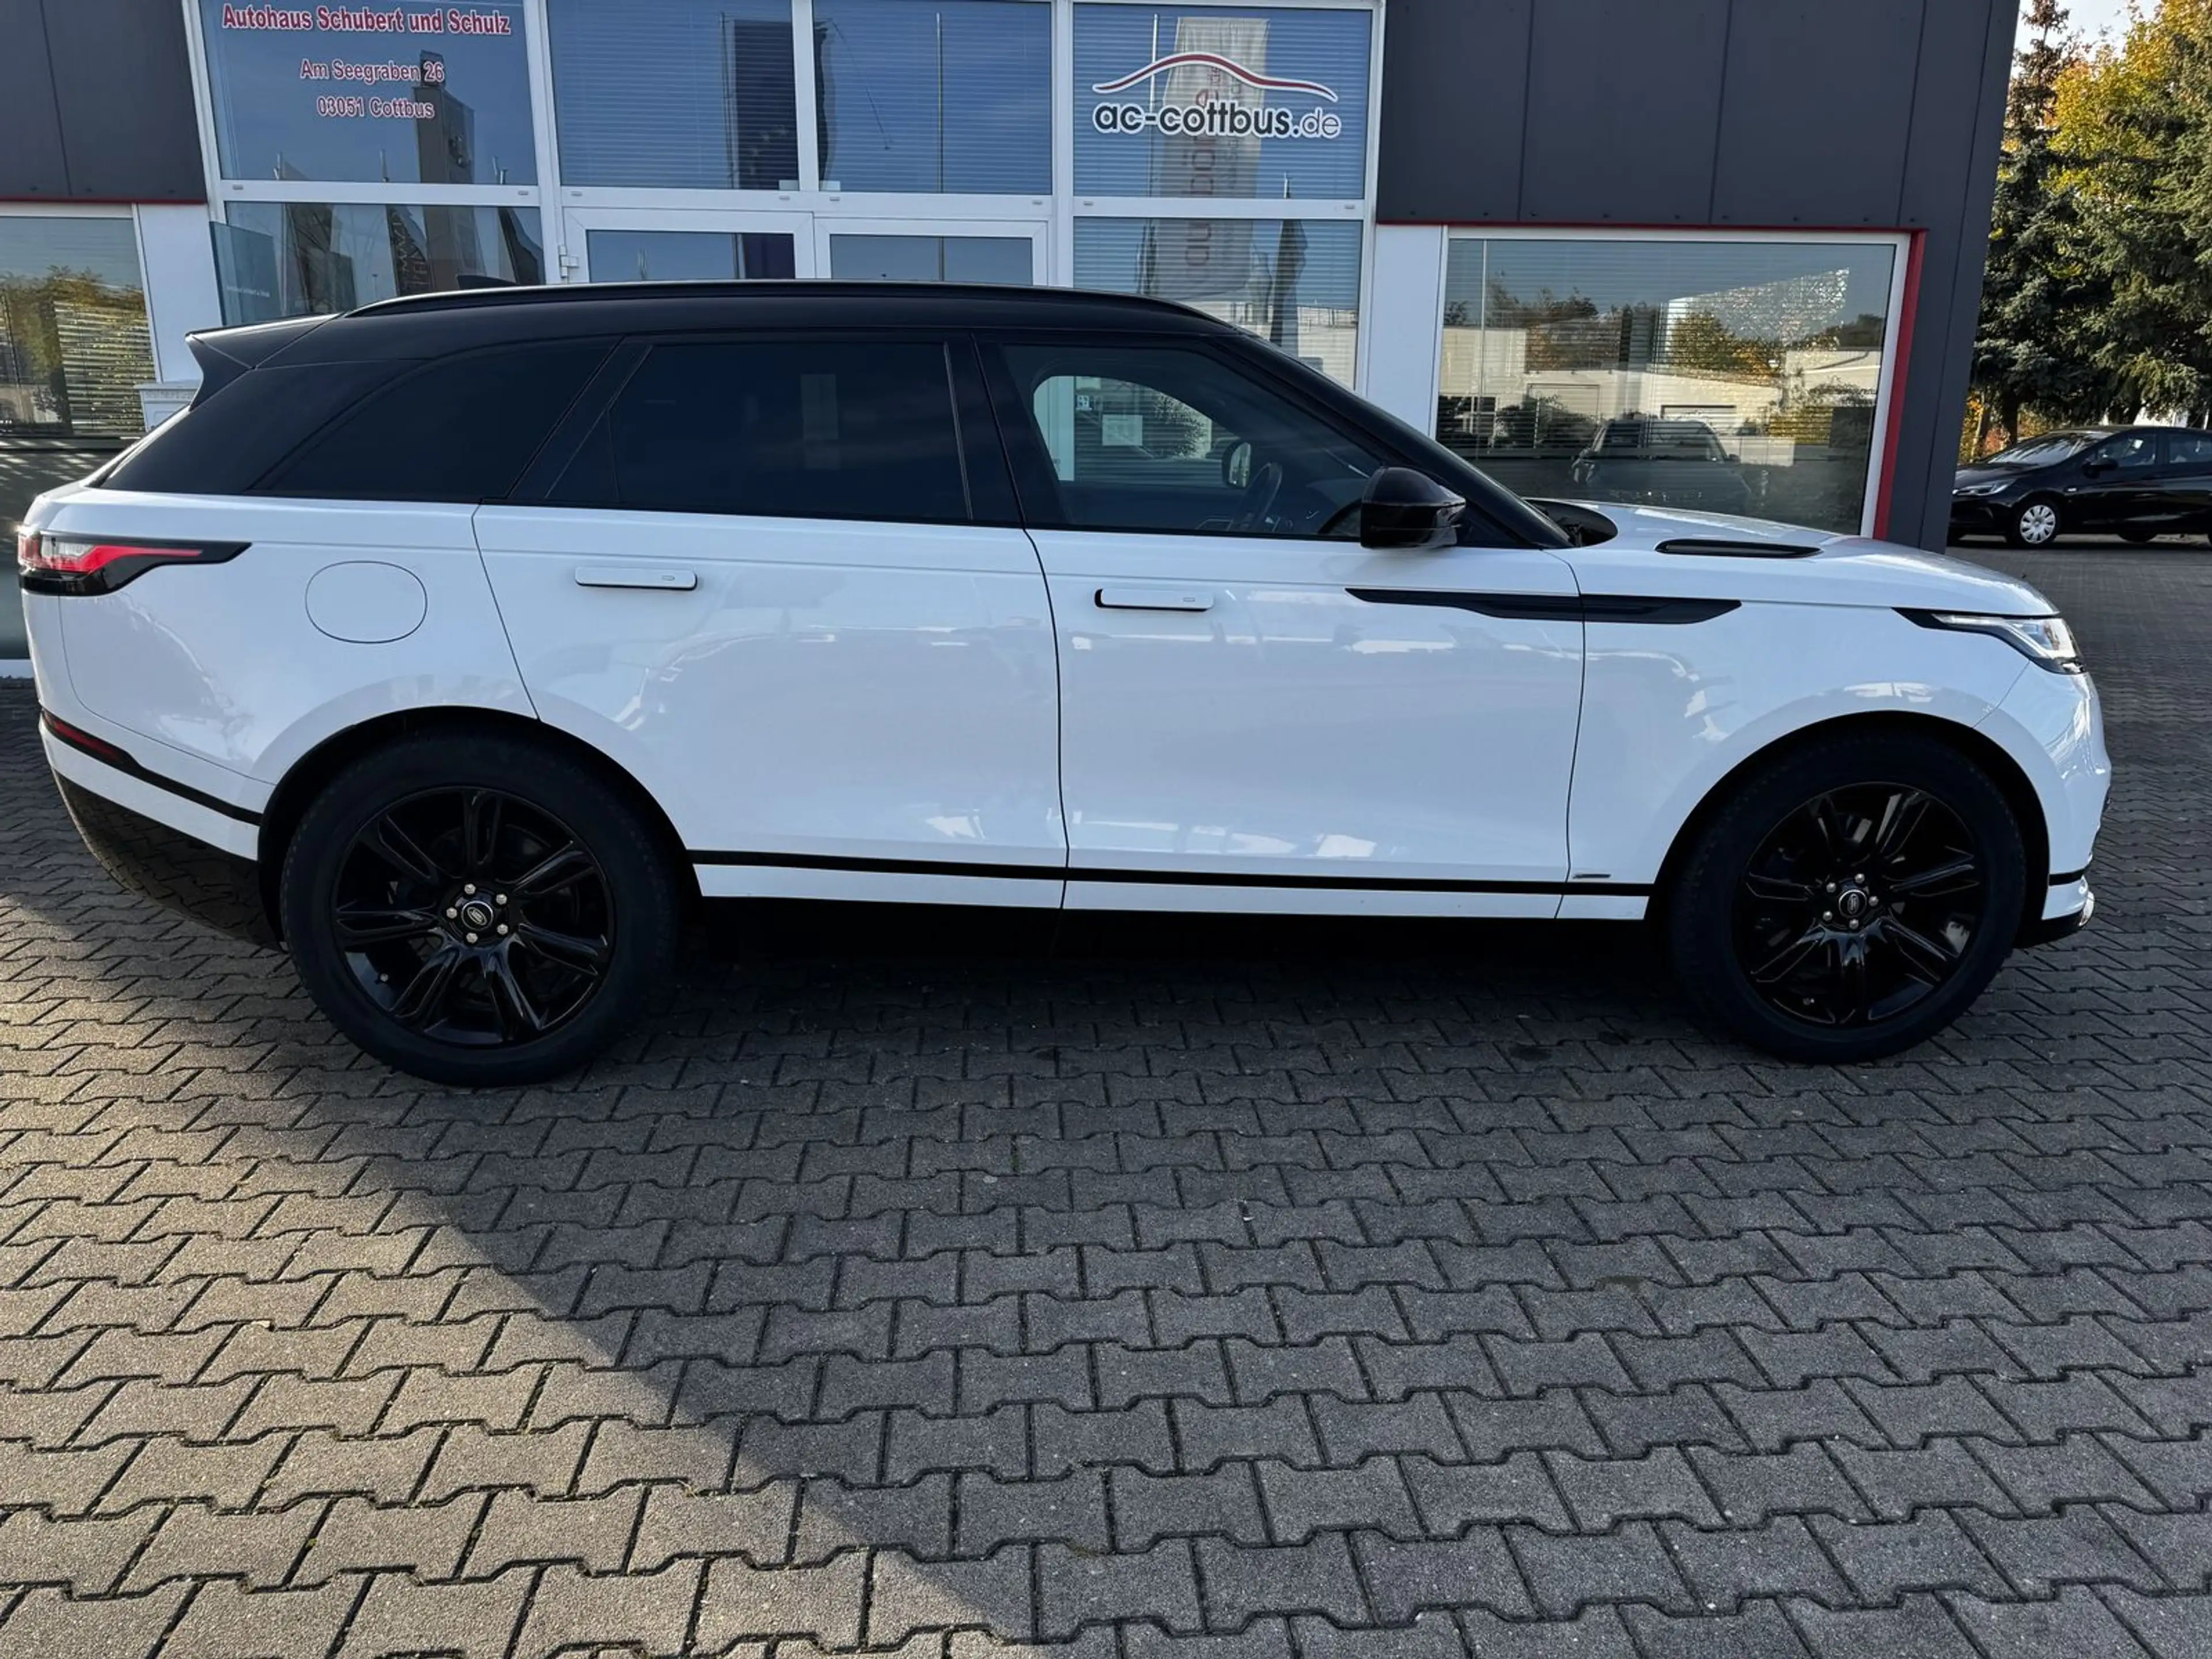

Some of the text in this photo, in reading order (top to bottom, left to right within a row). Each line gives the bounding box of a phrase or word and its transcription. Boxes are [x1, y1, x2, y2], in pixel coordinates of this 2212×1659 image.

[223, 4, 510, 35] Autohaus Schubert und Schulz
[301, 59, 444, 84] Am Seegraben 26
[317, 96, 434, 118] 03051 Cottbus
[1094, 101, 1341, 137] ac-cottbus.de
